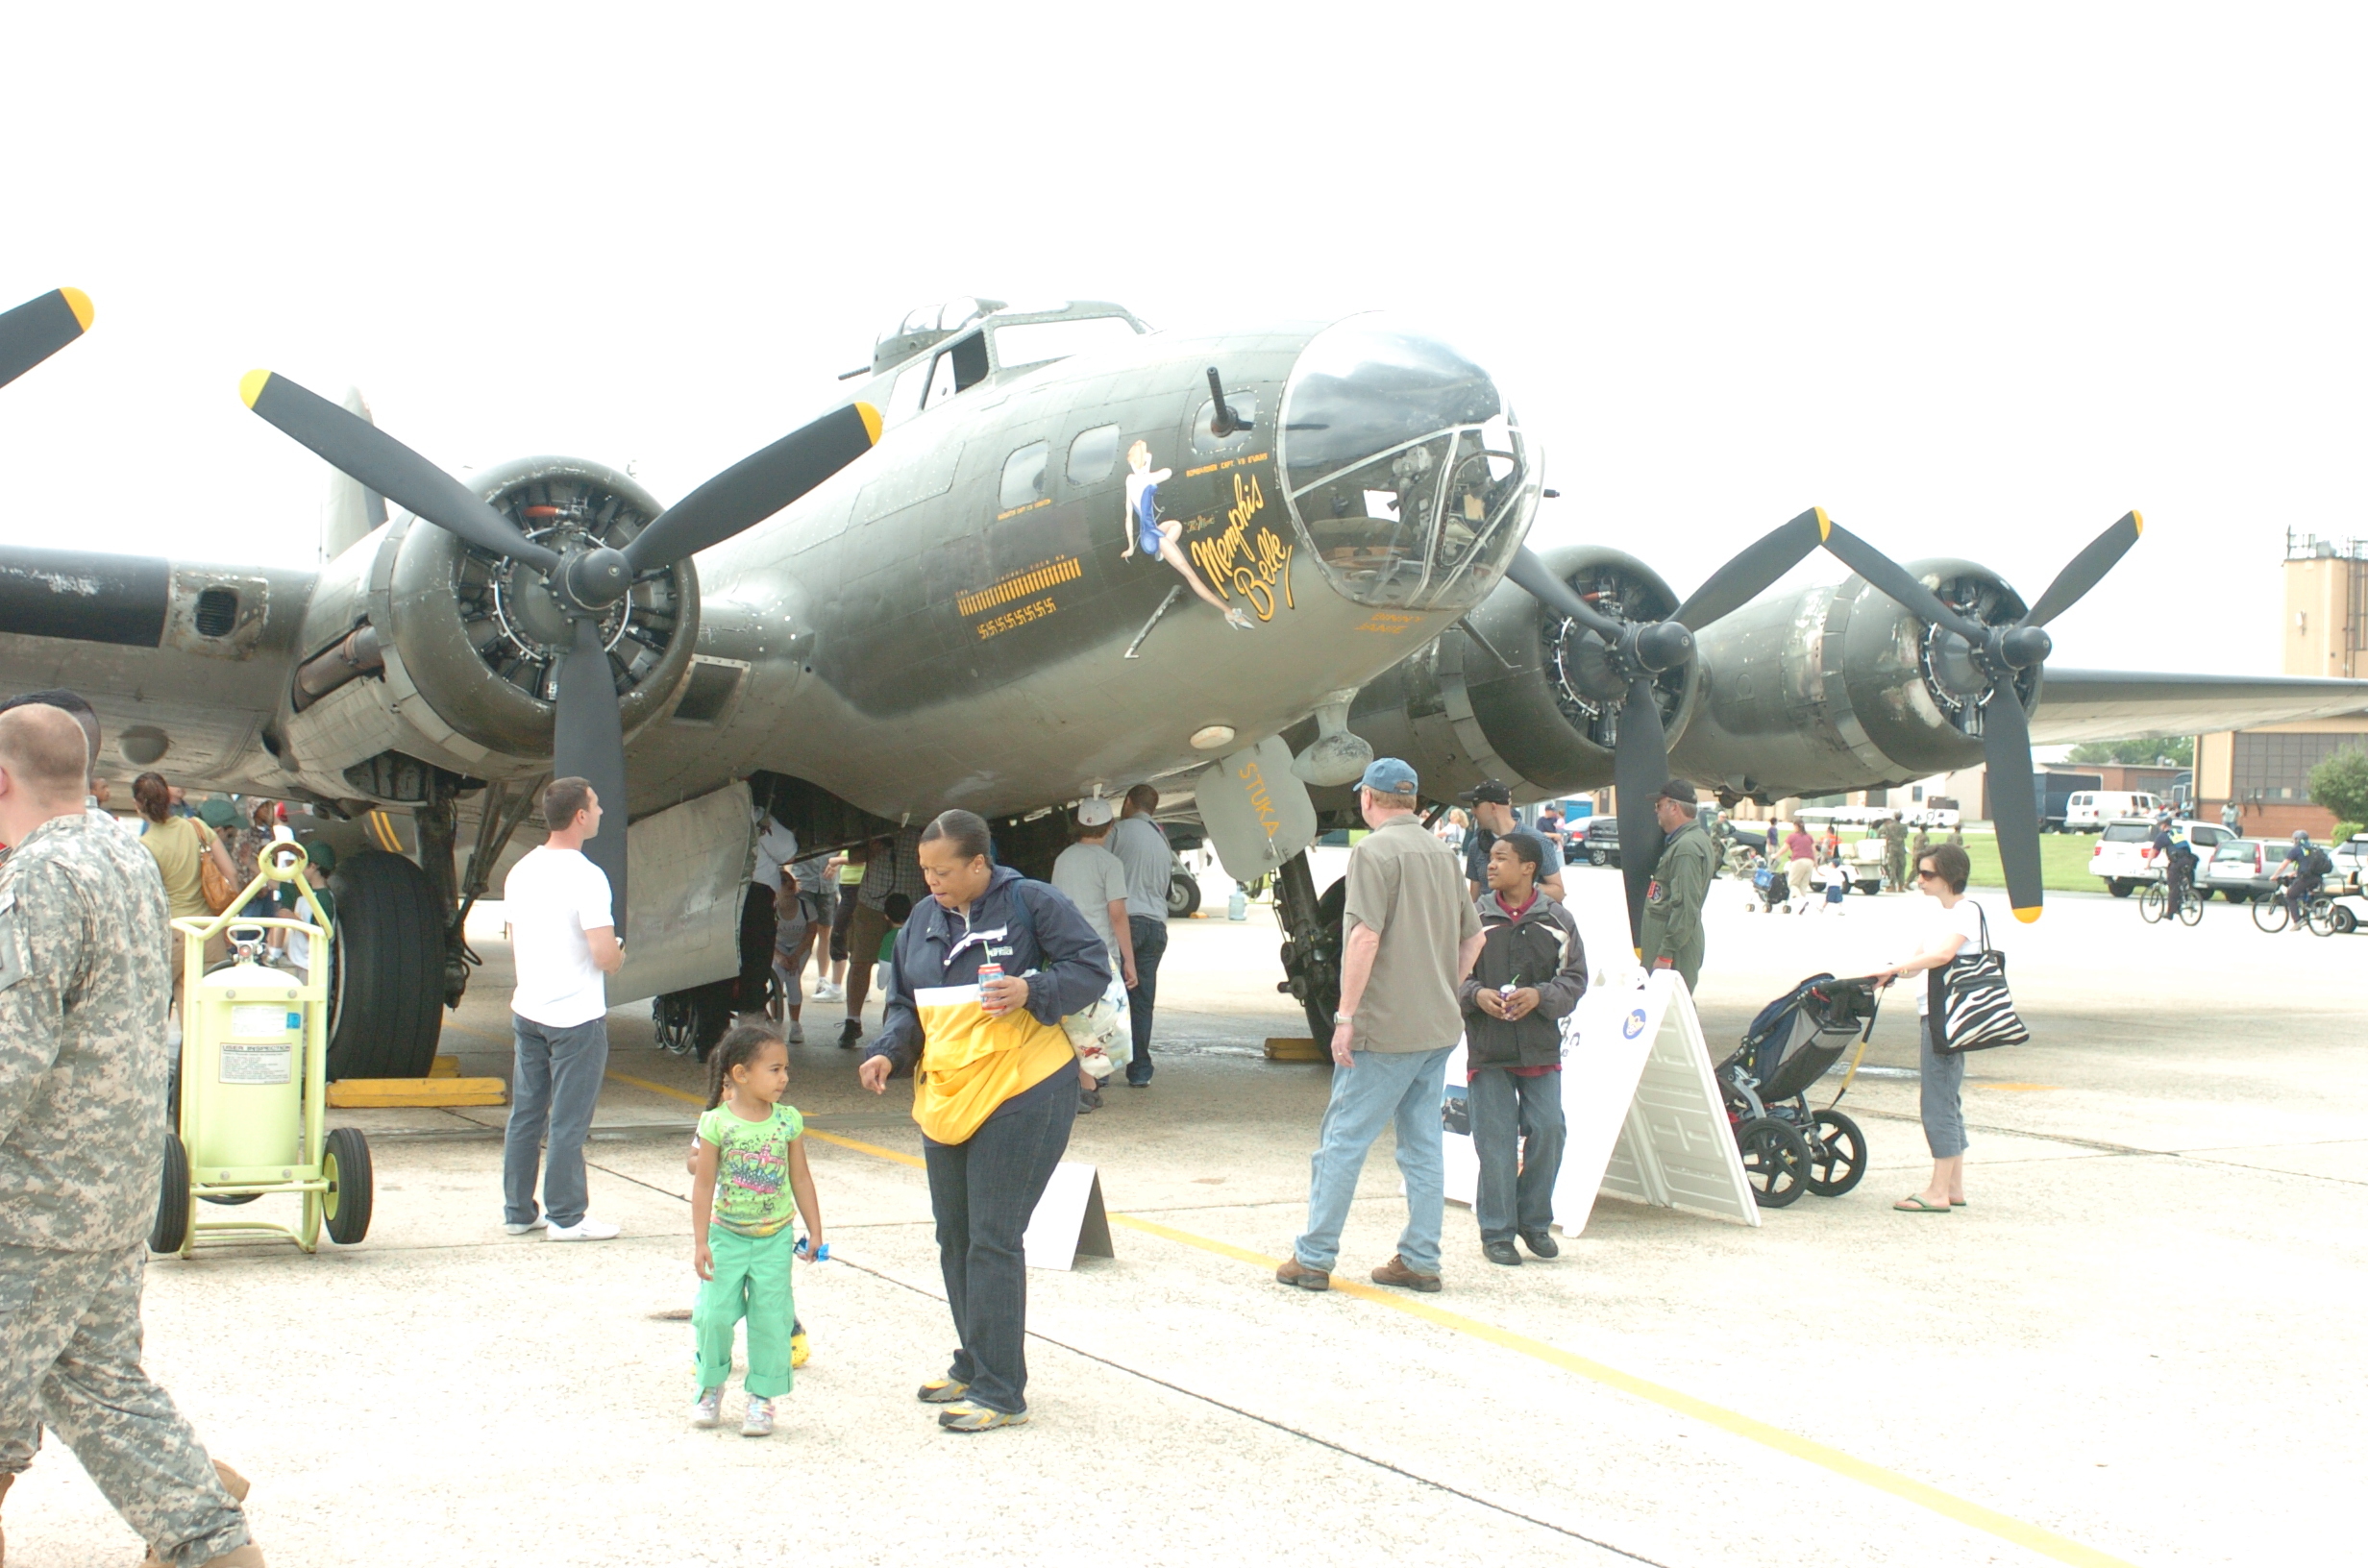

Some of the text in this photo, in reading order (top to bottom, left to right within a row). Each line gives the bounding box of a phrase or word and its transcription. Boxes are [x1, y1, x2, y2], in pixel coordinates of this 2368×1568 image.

[1191, 473, 1264, 600] Memphis
[1234, 527, 1287, 622] Belle
[1238, 762, 1280, 838] STUKA
